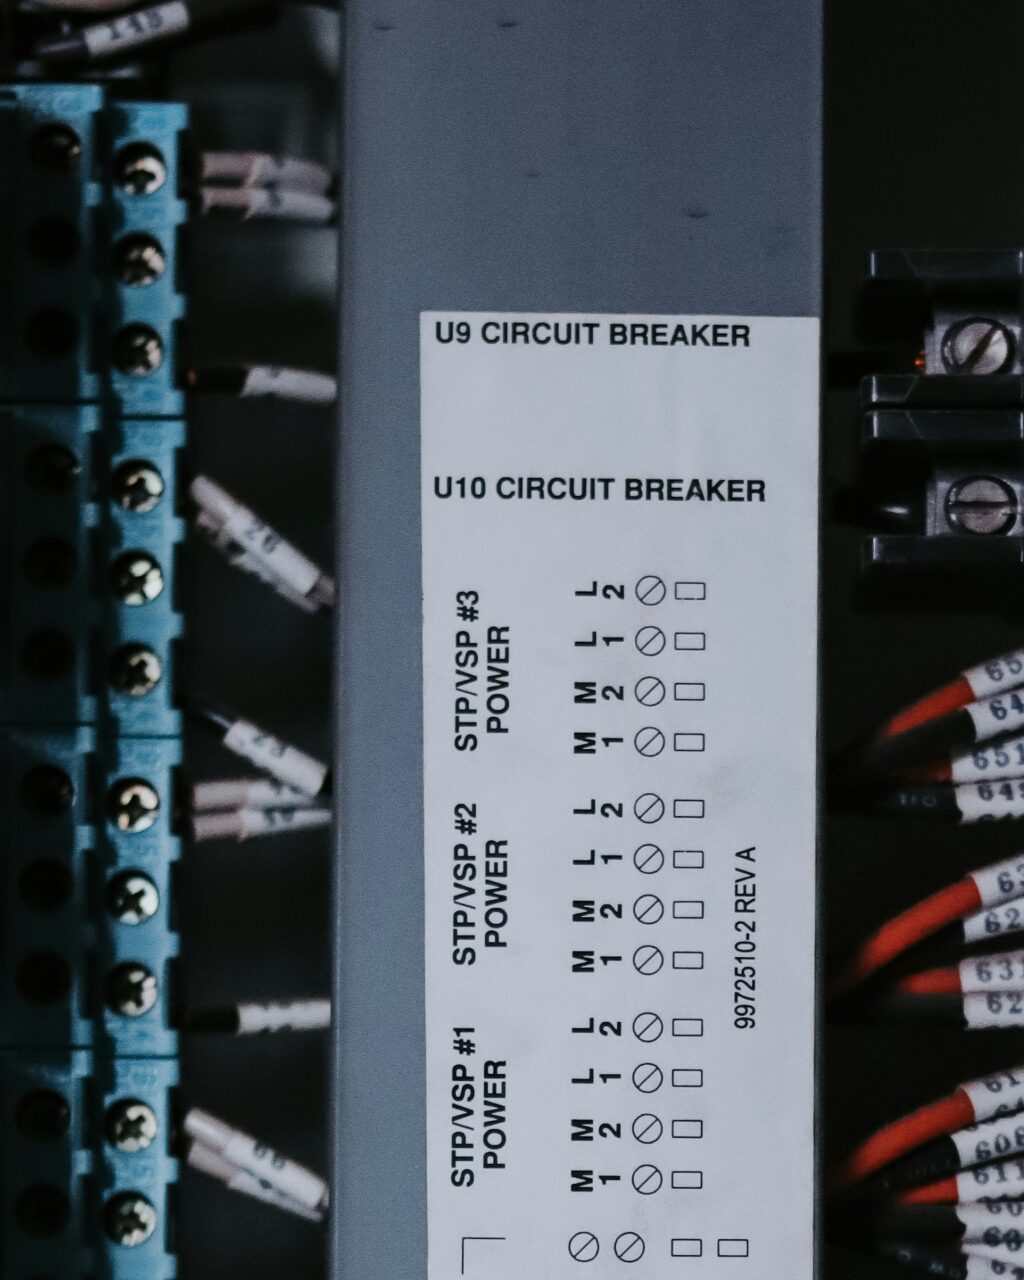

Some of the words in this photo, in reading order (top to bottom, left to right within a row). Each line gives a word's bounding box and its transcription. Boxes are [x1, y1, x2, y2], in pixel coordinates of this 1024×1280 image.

[436, 322, 470, 343] U9
[481, 322, 600, 345] CIRCUIT
[610, 324, 749, 346] BREAKER
[435, 477, 486, 499] U10
[496, 477, 615, 500] CIRCUIT
[625, 479, 765, 502] BREAKER
[575, 581, 597, 596] L
[602, 585, 624, 599] 2
[456, 591, 478, 622] #3
[575, 632, 596, 646] L
[603, 637, 624, 646] 1
[487, 626, 509, 733] POWER
[454, 631, 478, 751] STP/VSP
[574, 682, 596, 703] M
[602, 686, 624, 700] 2
[574, 732, 596, 754] M
[602, 738, 623, 747] 1
[573, 799, 595, 814] L
[601, 803, 622, 817] 2
[454, 804, 476, 835] #2
[573, 850, 595, 865] L
[601, 855, 622, 864] 1
[735, 847, 755, 862] A
[485, 840, 507, 947] POWER
[735, 868, 756, 914] REV
[453, 844, 476, 965] STP/VSP
[573, 901, 594, 922] M
[600, 904, 622, 918] 2
[572, 951, 594, 972] M
[600, 956, 622, 965] 1
[734, 921, 756, 1029] 9972510-2
[572, 1018, 594, 1033] L
[599, 1022, 621, 1036] 2
[453, 1028, 475, 1055] #1
[572, 1069, 594, 1083] L
[599, 1074, 621, 1083] 1
[483, 1061, 506, 1168] POWER
[451, 1064, 475, 1187] STP/VSP
[571, 1119, 593, 1141] M
[599, 1123, 621, 1138] 2
[571, 1170, 593, 1192] M
[599, 1176, 620, 1185] 1
